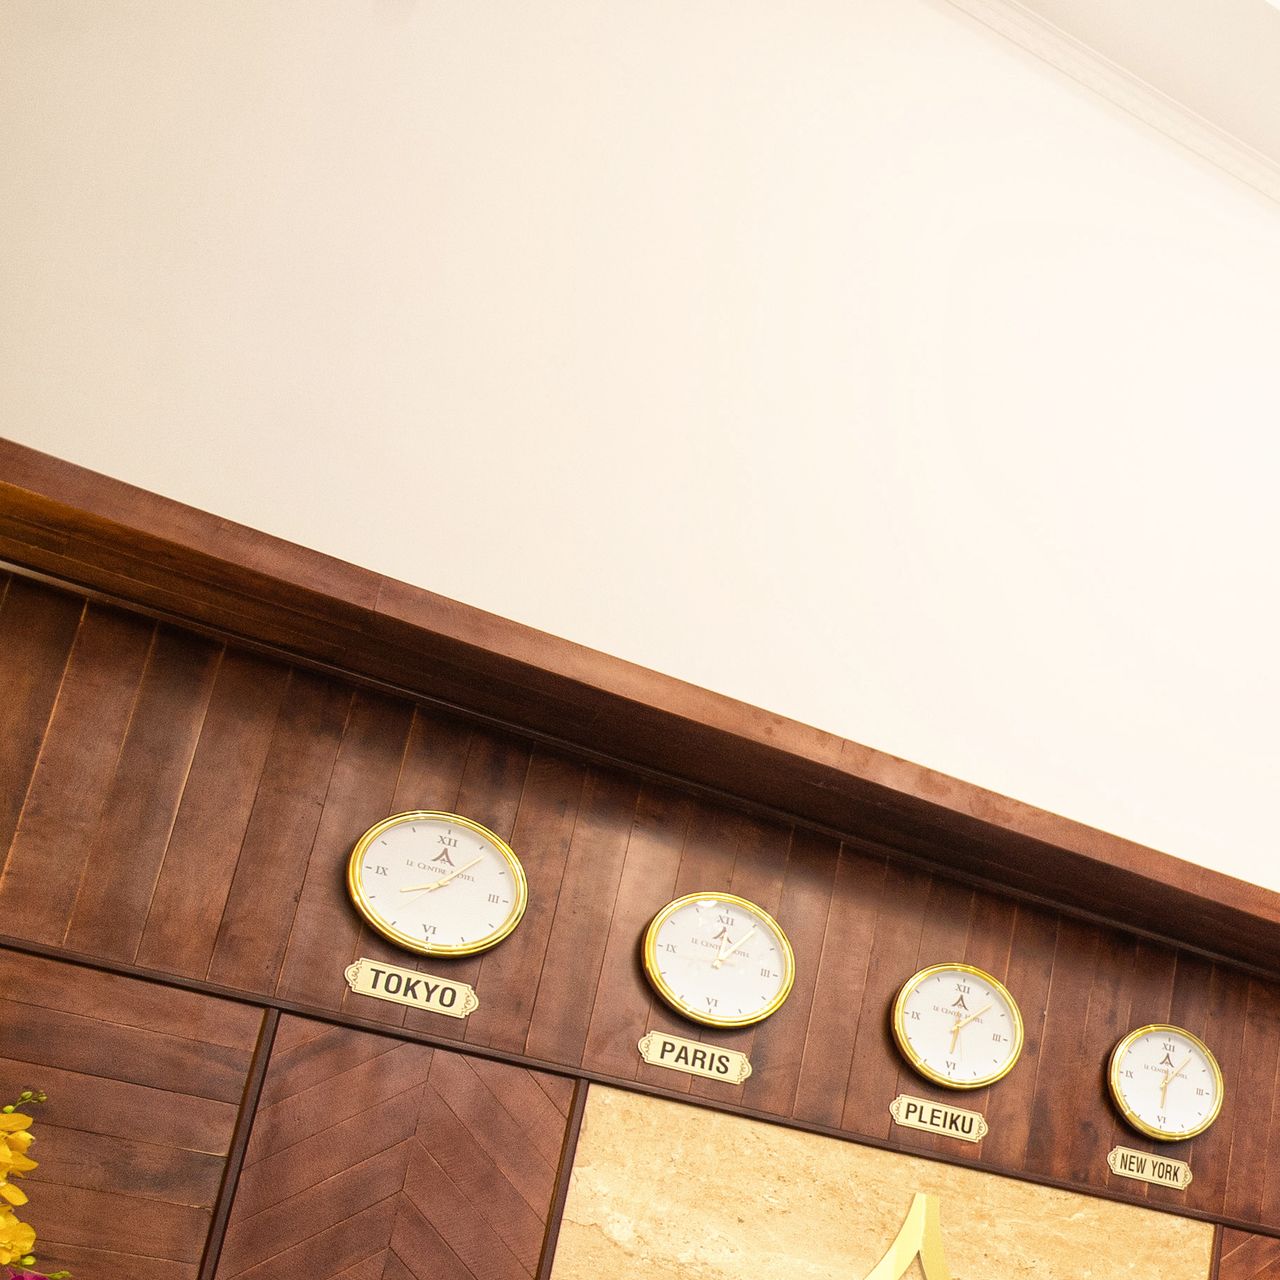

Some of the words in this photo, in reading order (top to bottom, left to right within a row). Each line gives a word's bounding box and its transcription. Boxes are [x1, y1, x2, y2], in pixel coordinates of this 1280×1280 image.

[437, 835, 457, 848] XII
[375, 865, 389, 876] IX
[487, 893, 500, 904] III
[717, 914, 735, 926] XII
[422, 923, 437, 935] VI
[666, 943, 677, 953] IX
[760, 968, 771, 978] III
[370, 968, 457, 1008] TOKYO
[955, 983, 970, 994] XII
[706, 997, 719, 1008] VI
[911, 1010, 920, 1020] IX
[992, 1033, 1001, 1042] III
[1161, 1042, 1175, 1053] XII
[660, 1041, 730, 1074] PARIS
[945, 1060, 957, 1070] VI
[1125, 1070, 1134, 1079] IX
[905, 1102, 974, 1134] PLEIKU
[1157, 1115, 1166, 1124] VI
[1120, 1153, 1147, 1174] NEW
[1152, 1160, 1180, 1182] YORK
